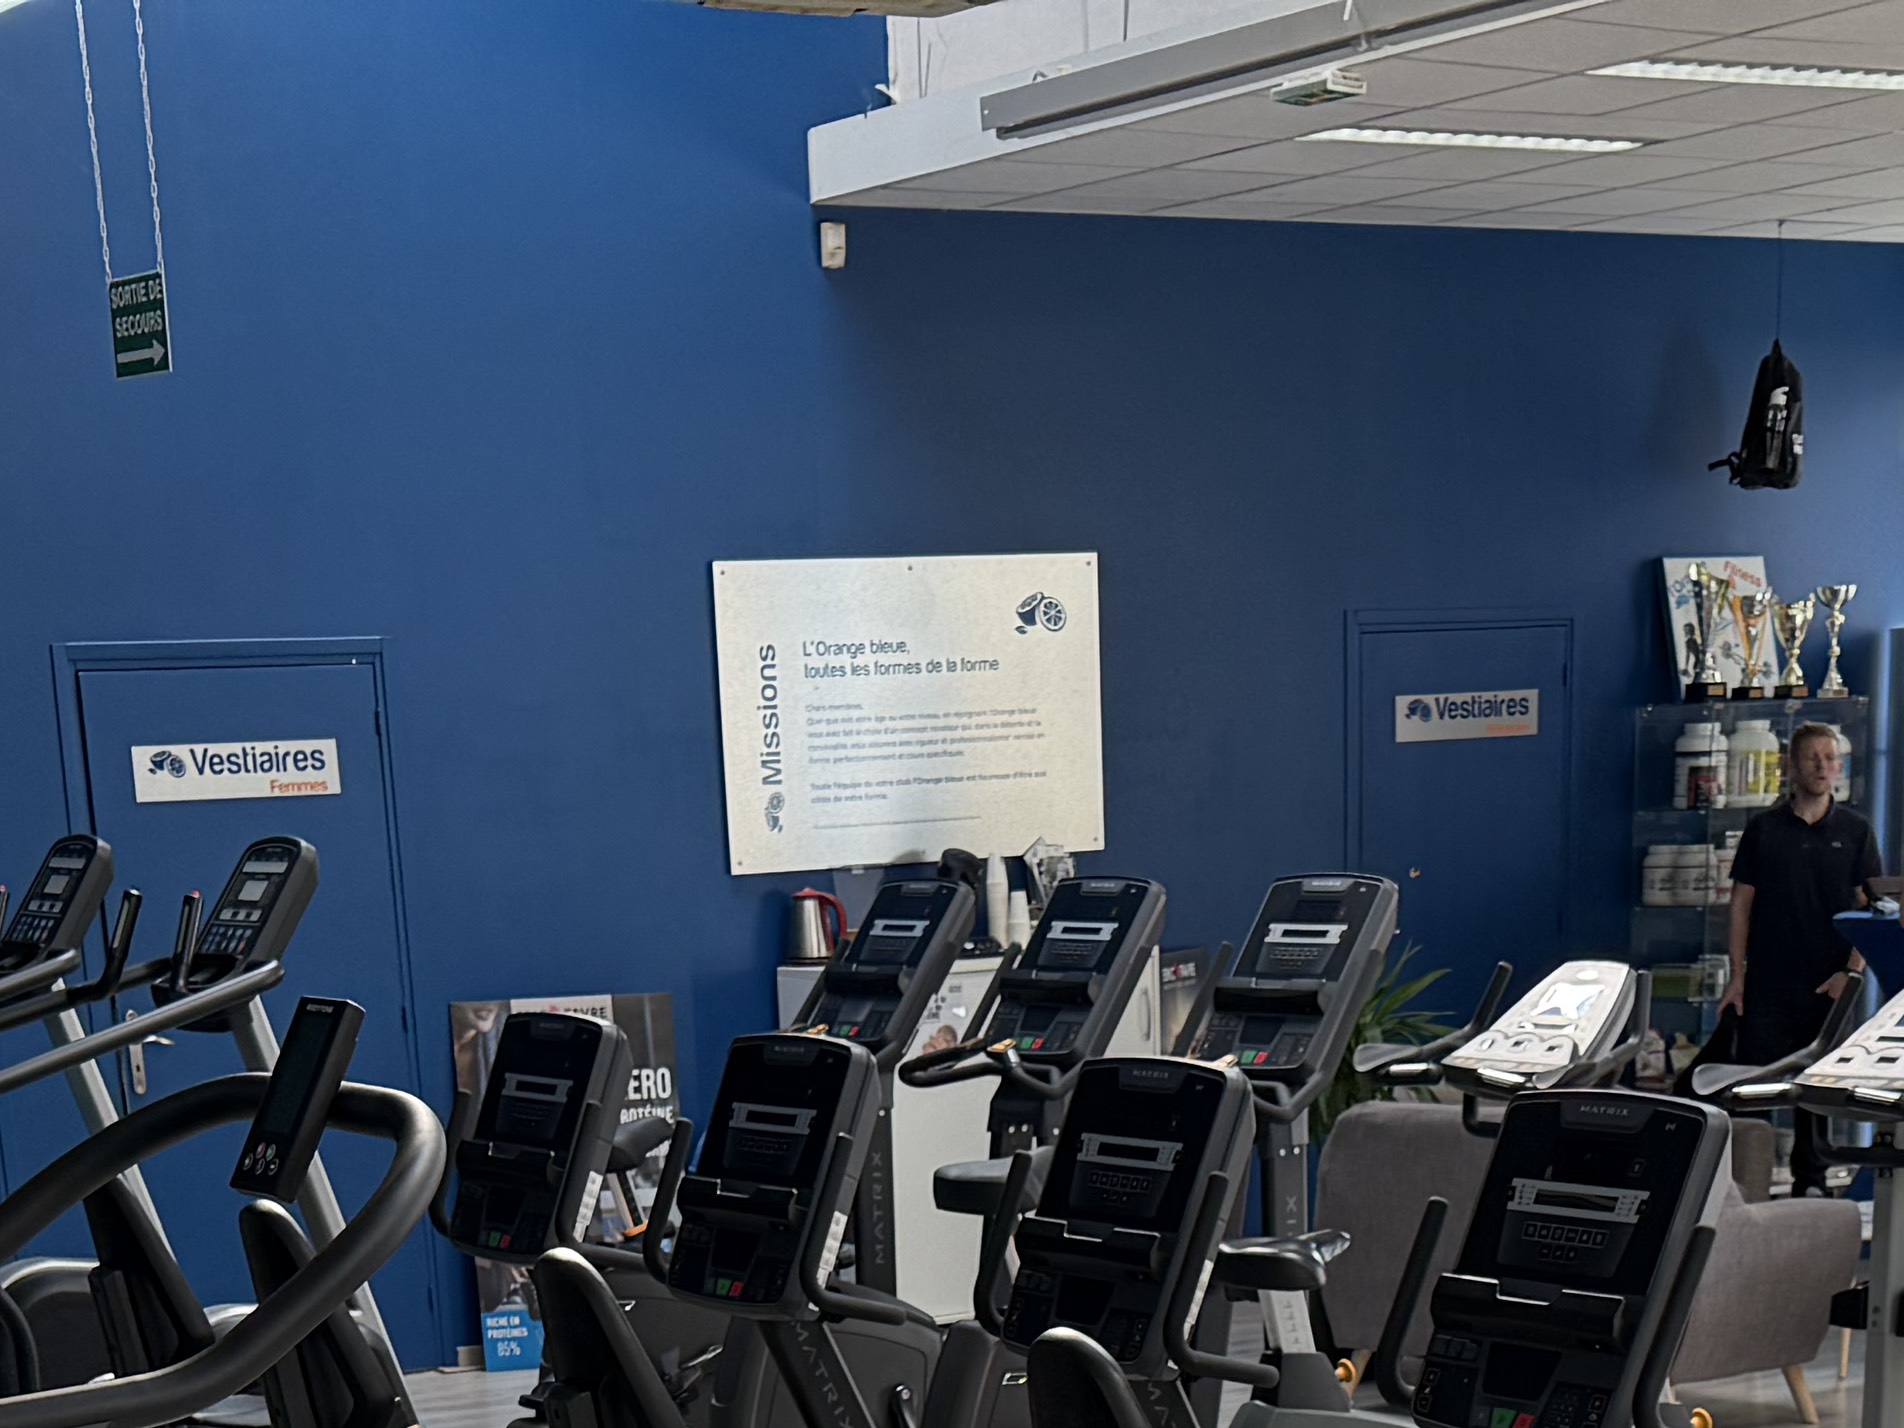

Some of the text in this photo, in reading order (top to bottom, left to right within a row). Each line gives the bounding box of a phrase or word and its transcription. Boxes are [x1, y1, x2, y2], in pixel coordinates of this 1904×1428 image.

[110, 280, 163, 309] SORTIE DE
[115, 310, 163, 337] SECOURS
[802, 639, 911, 659] L'Orange bleue,
[804, 662, 846, 678] toutes
[850, 661, 870, 676] les
[873, 660, 922, 675] formes
[925, 658, 943, 673] de
[960, 657, 1000, 672] forme
[757, 644, 783, 785] Missions
[1435, 694, 1529, 721] Vestiaires
[190, 745, 326, 777] Vestiaires
[270, 779, 328, 795] Femmes
[626, 1067, 673, 1101] ERO
[1580, 1104, 1629, 1117] MATRIX
[871, 1150, 886, 1266] MATRIX
